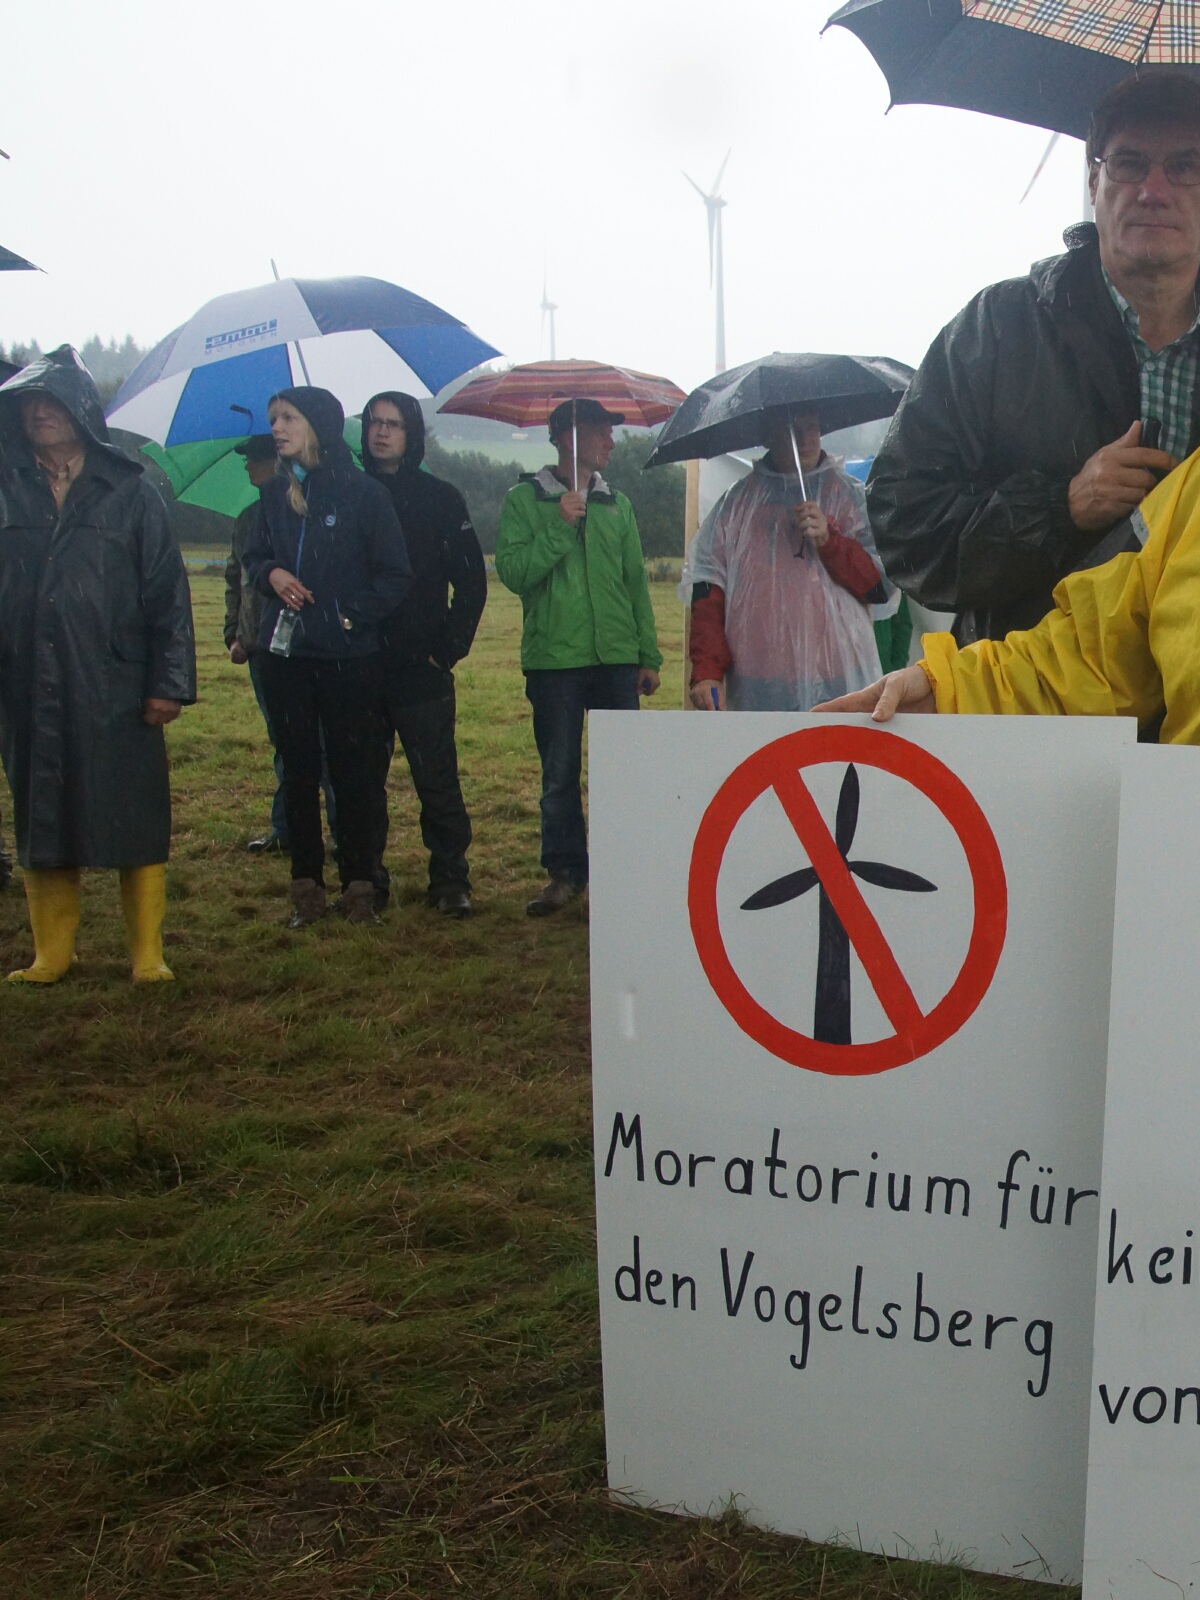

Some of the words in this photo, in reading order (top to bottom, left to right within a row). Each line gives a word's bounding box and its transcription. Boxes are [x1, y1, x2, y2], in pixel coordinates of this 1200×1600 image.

[205, 331, 277, 355] MOTOREN
[602, 1111, 972, 1217] Moratorium
[997, 1149, 1099, 1230] für
[614, 1234, 697, 1312] den
[720, 1247, 1054, 1399] Vogelsberg
